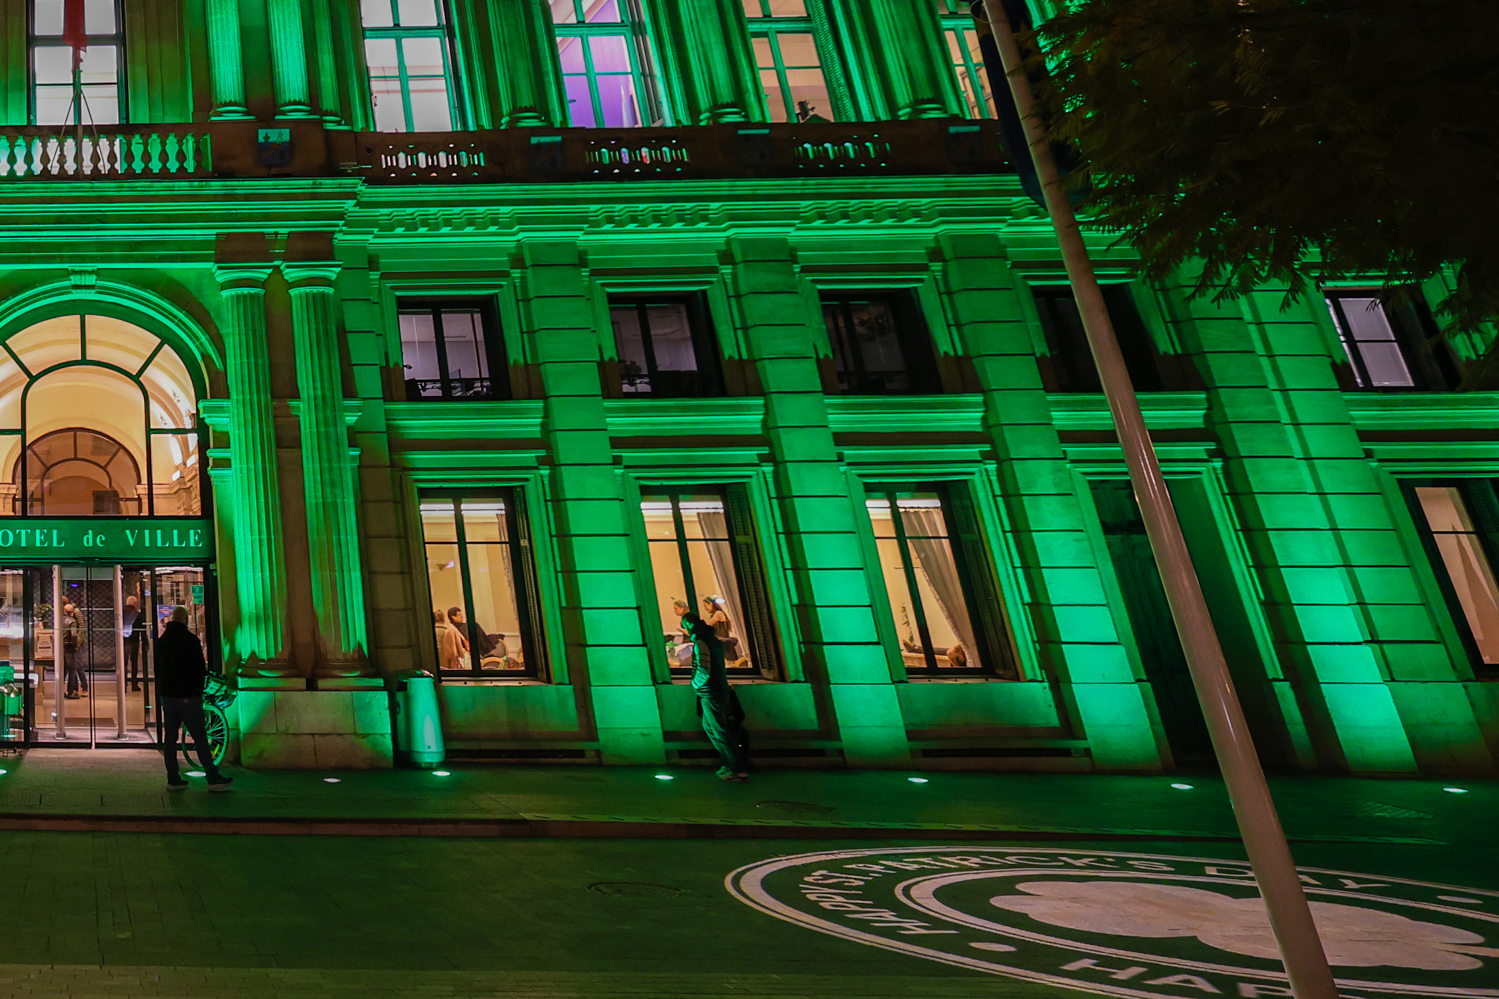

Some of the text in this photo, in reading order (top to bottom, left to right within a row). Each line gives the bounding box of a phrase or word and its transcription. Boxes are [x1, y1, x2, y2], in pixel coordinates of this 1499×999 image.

[82, 528, 106, 547] de
[125, 528, 203, 548] VILLE
[843, 855, 1176, 874] PATRICK'S
[803, 869, 883, 886] ST.
[798, 883, 960, 935] HAPPY
